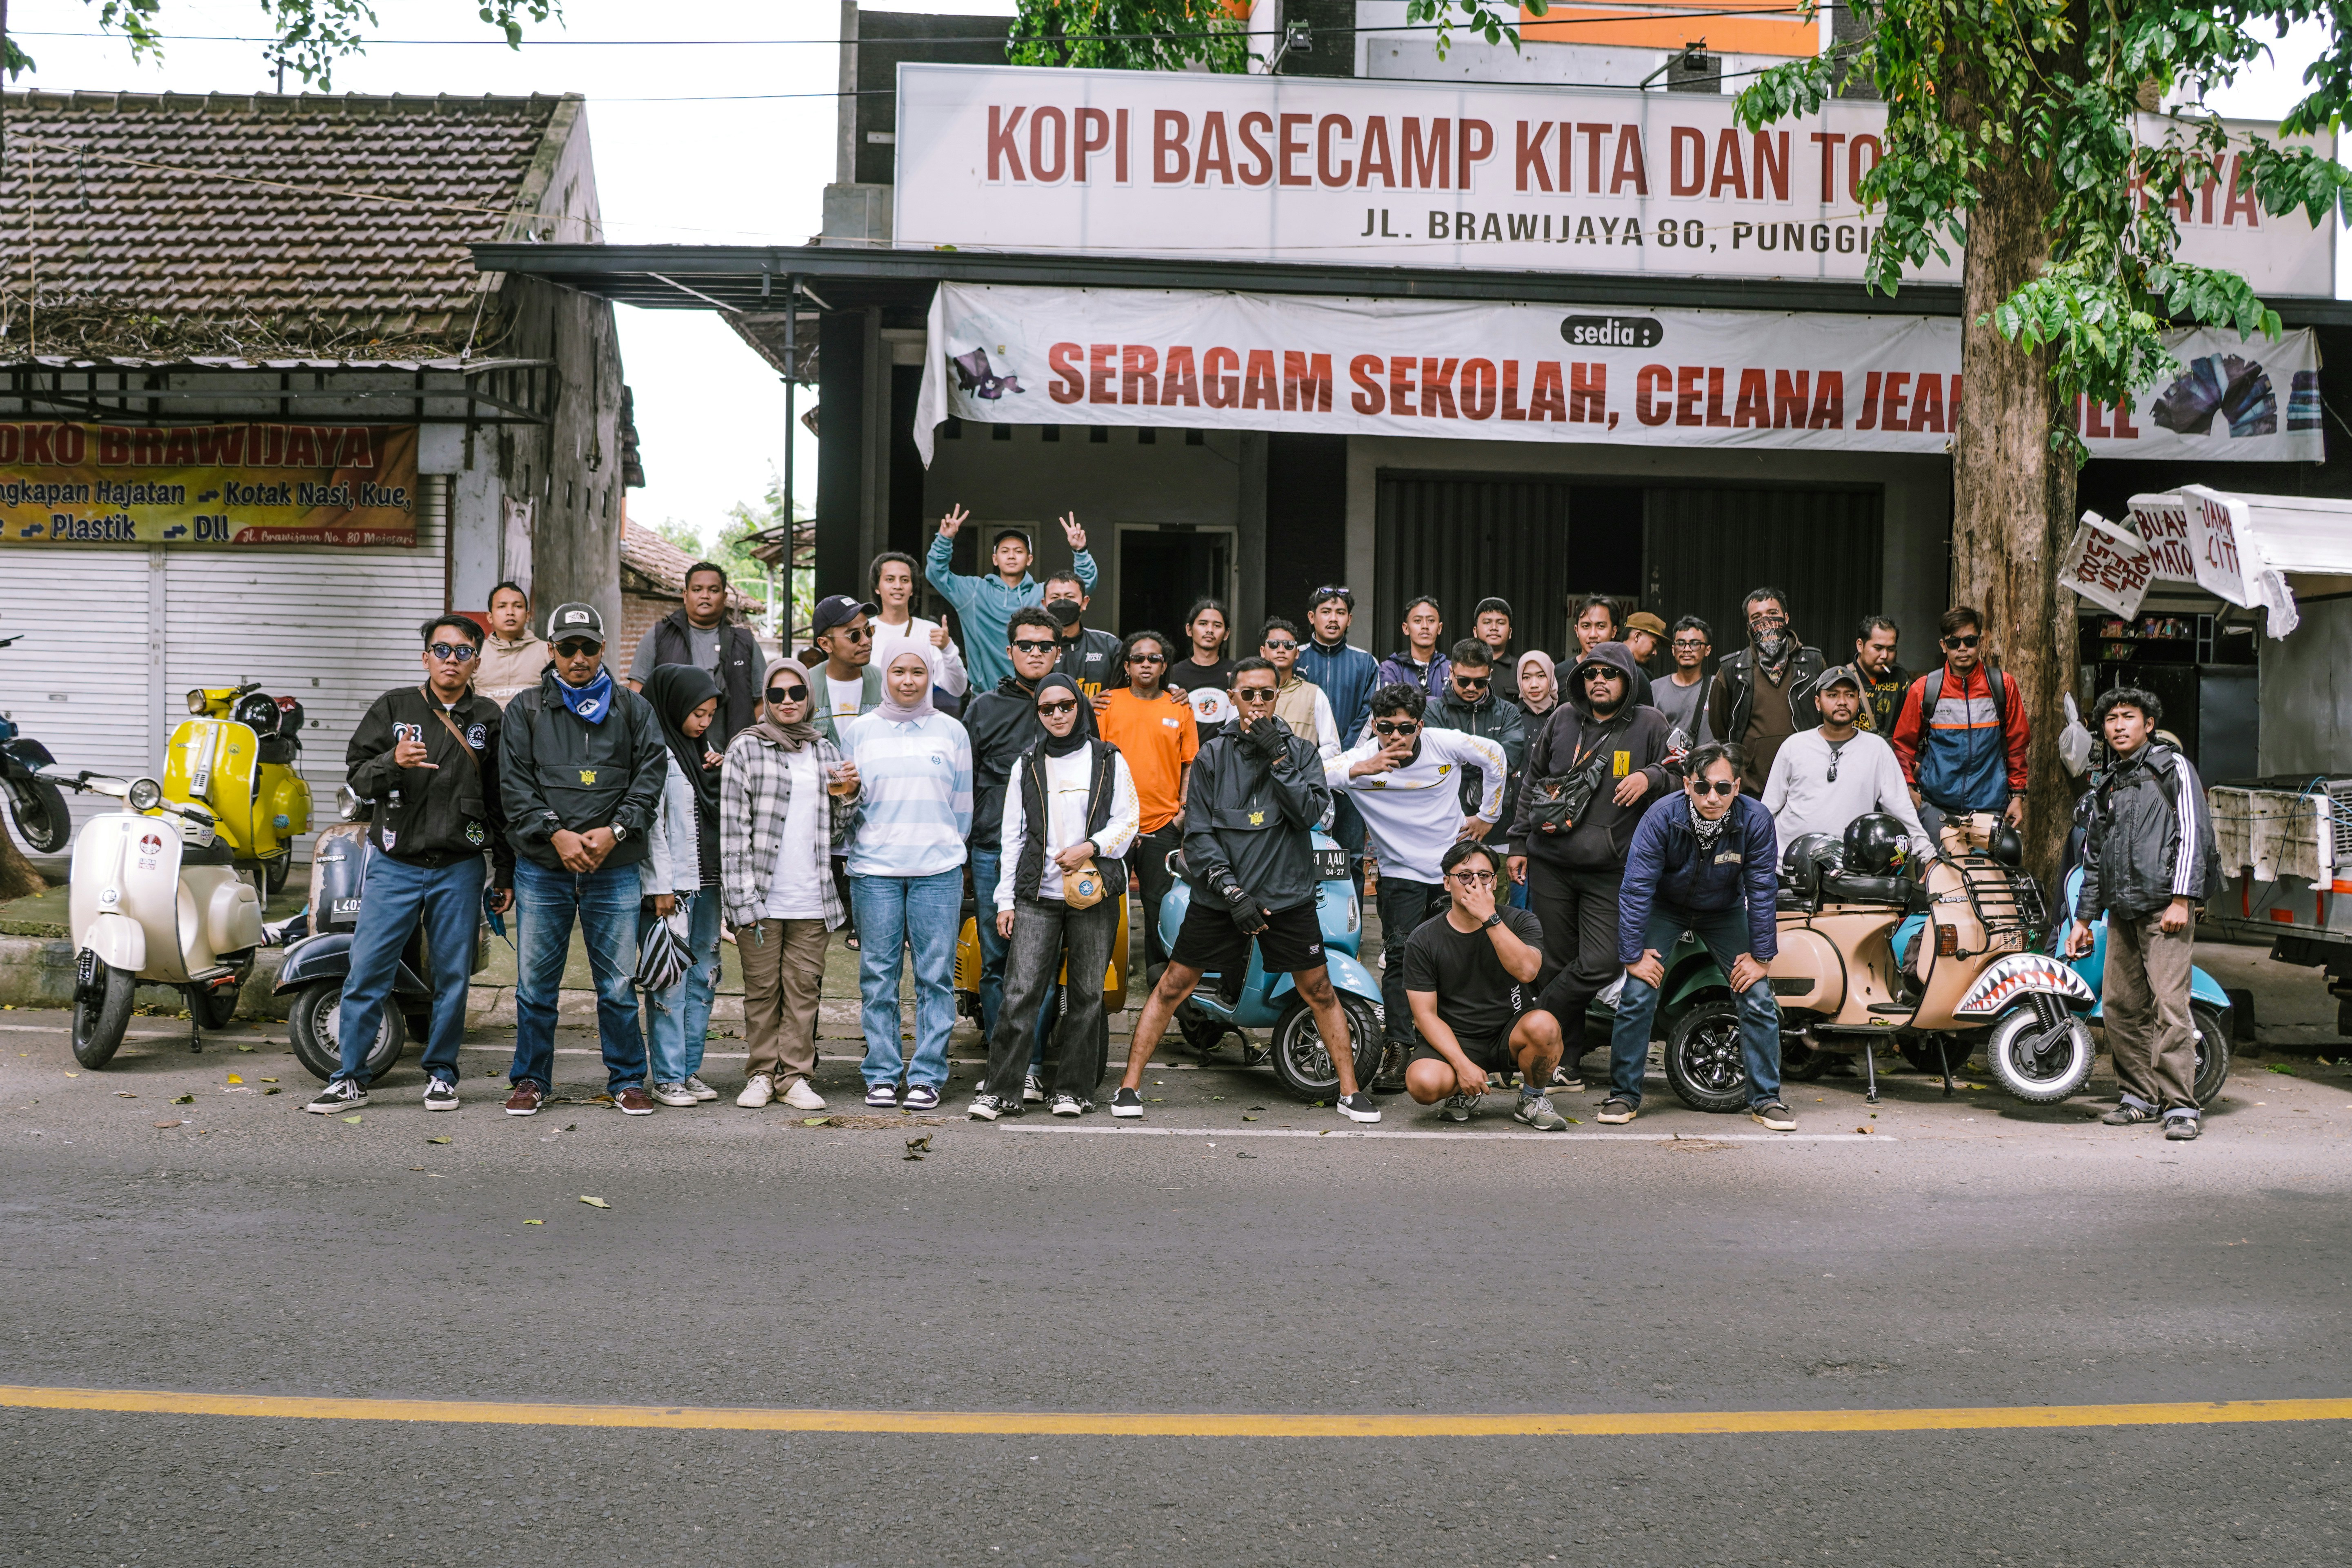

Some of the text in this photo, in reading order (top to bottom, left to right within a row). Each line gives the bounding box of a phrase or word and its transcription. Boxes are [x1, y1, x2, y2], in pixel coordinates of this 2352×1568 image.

[988, 106, 1127, 181] KOPI
[1154, 110, 1493, 189] BASECAMP
[1516, 121, 1648, 194] KITA
[1671, 127, 1789, 200] DAN
[1362, 209, 1412, 237] JL.
[1429, 211, 1643, 246] BRAWIJAYA
[1658, 219, 1717, 253] 80,
[1574, 319, 1634, 345] sedia
[1049, 342, 1332, 412] SERAGAM
[1349, 354, 1618, 431] SEKOLAH,
[1636, 364, 1843, 429] CELANA
[98, 425, 373, 468] BRAWIJAYA
[96, 480, 186, 509] Hajatan
[225, 482, 291, 507] Kotak
[298, 483, 355, 509] Nasi,
[361, 482, 412, 509] Kue,
[51, 514, 136, 540] Plastik
[262, 531, 322, 544] Brawijaya
[325, 531, 342, 543] No.
[347, 532, 360, 543] 80
[364, 532, 415, 545] Mojosari
[2147, 540, 2196, 579] MATO
[1327, 852, 1345, 865] AAU
[333, 900, 340, 912] L
